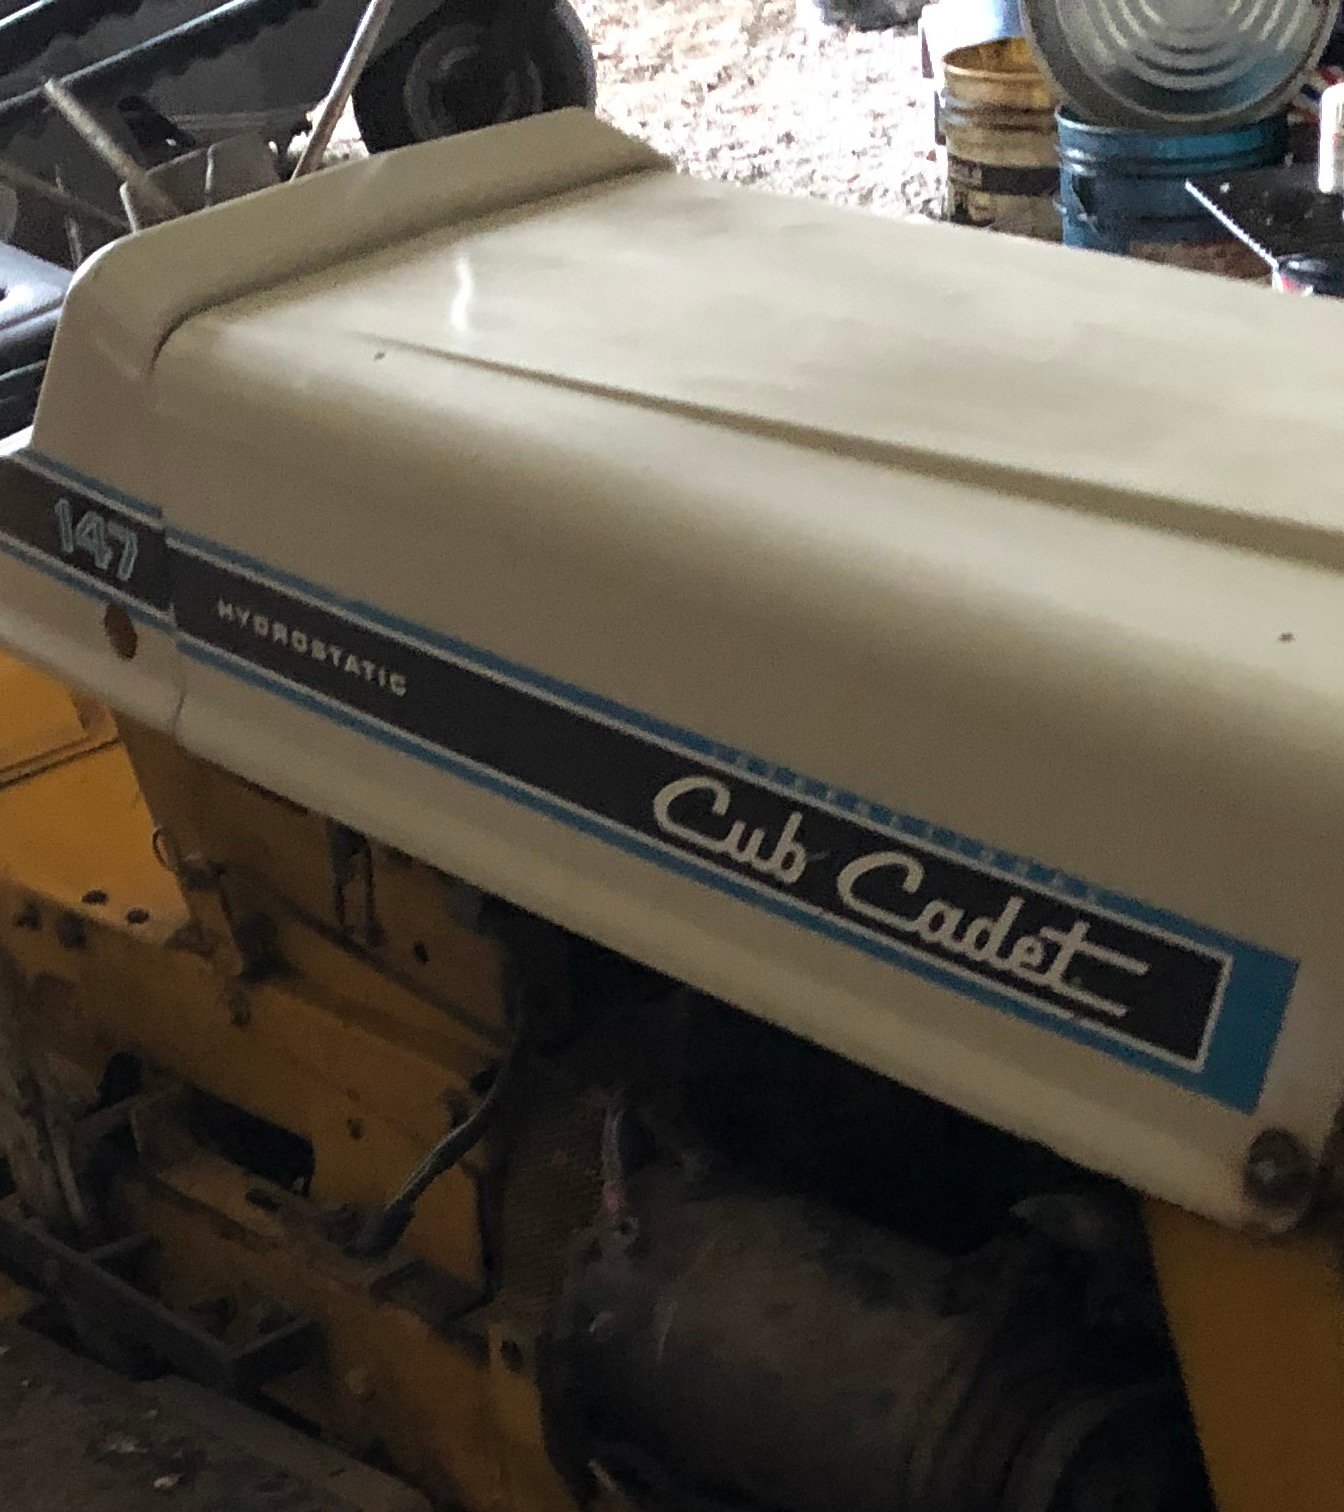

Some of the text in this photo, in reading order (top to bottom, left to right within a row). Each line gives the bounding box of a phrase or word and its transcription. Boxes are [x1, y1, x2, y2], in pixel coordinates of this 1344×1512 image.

[53, 498, 138, 581] 147
[217, 597, 408, 697] HYDROSTATIC
[653, 775, 1151, 1017] Cub Cadet
